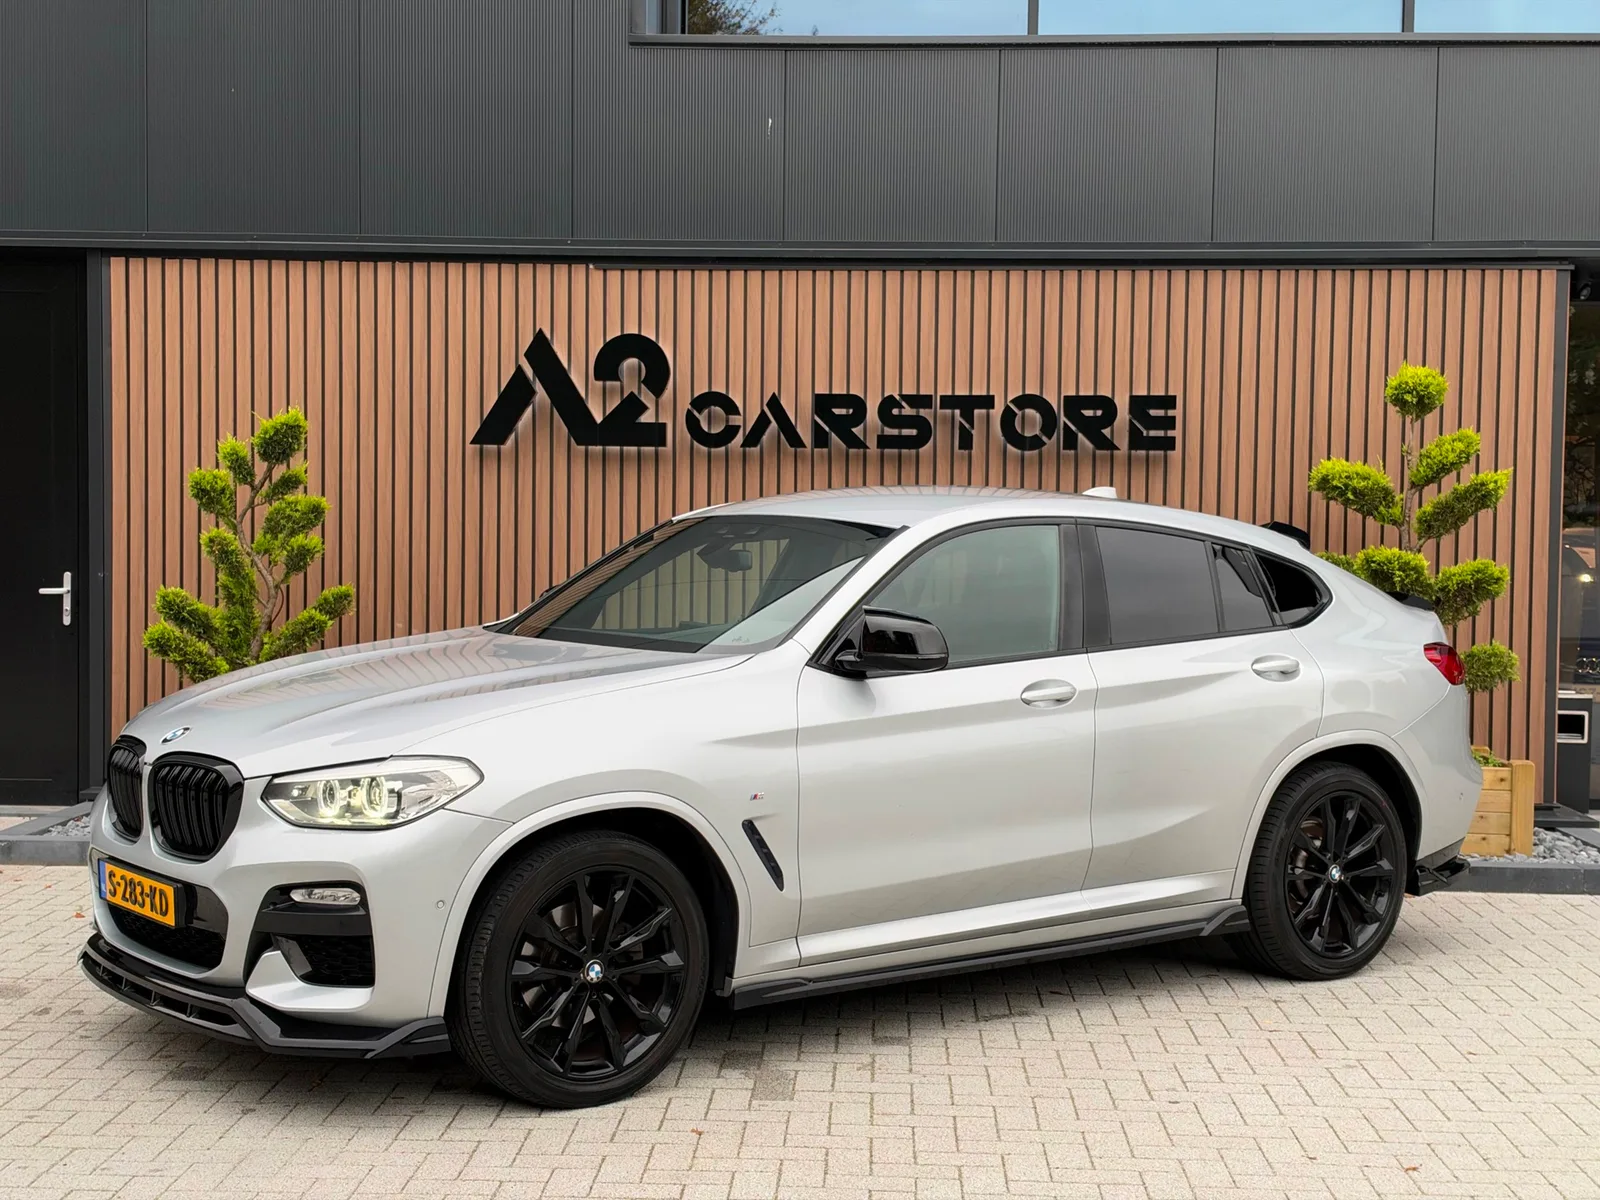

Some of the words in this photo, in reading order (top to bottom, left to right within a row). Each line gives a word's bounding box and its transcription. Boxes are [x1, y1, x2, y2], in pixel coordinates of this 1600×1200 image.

[469, 327, 671, 447] A2
[685, 391, 1177, 452] CARSTORE
[107, 869, 169, 918] S-283-KD
